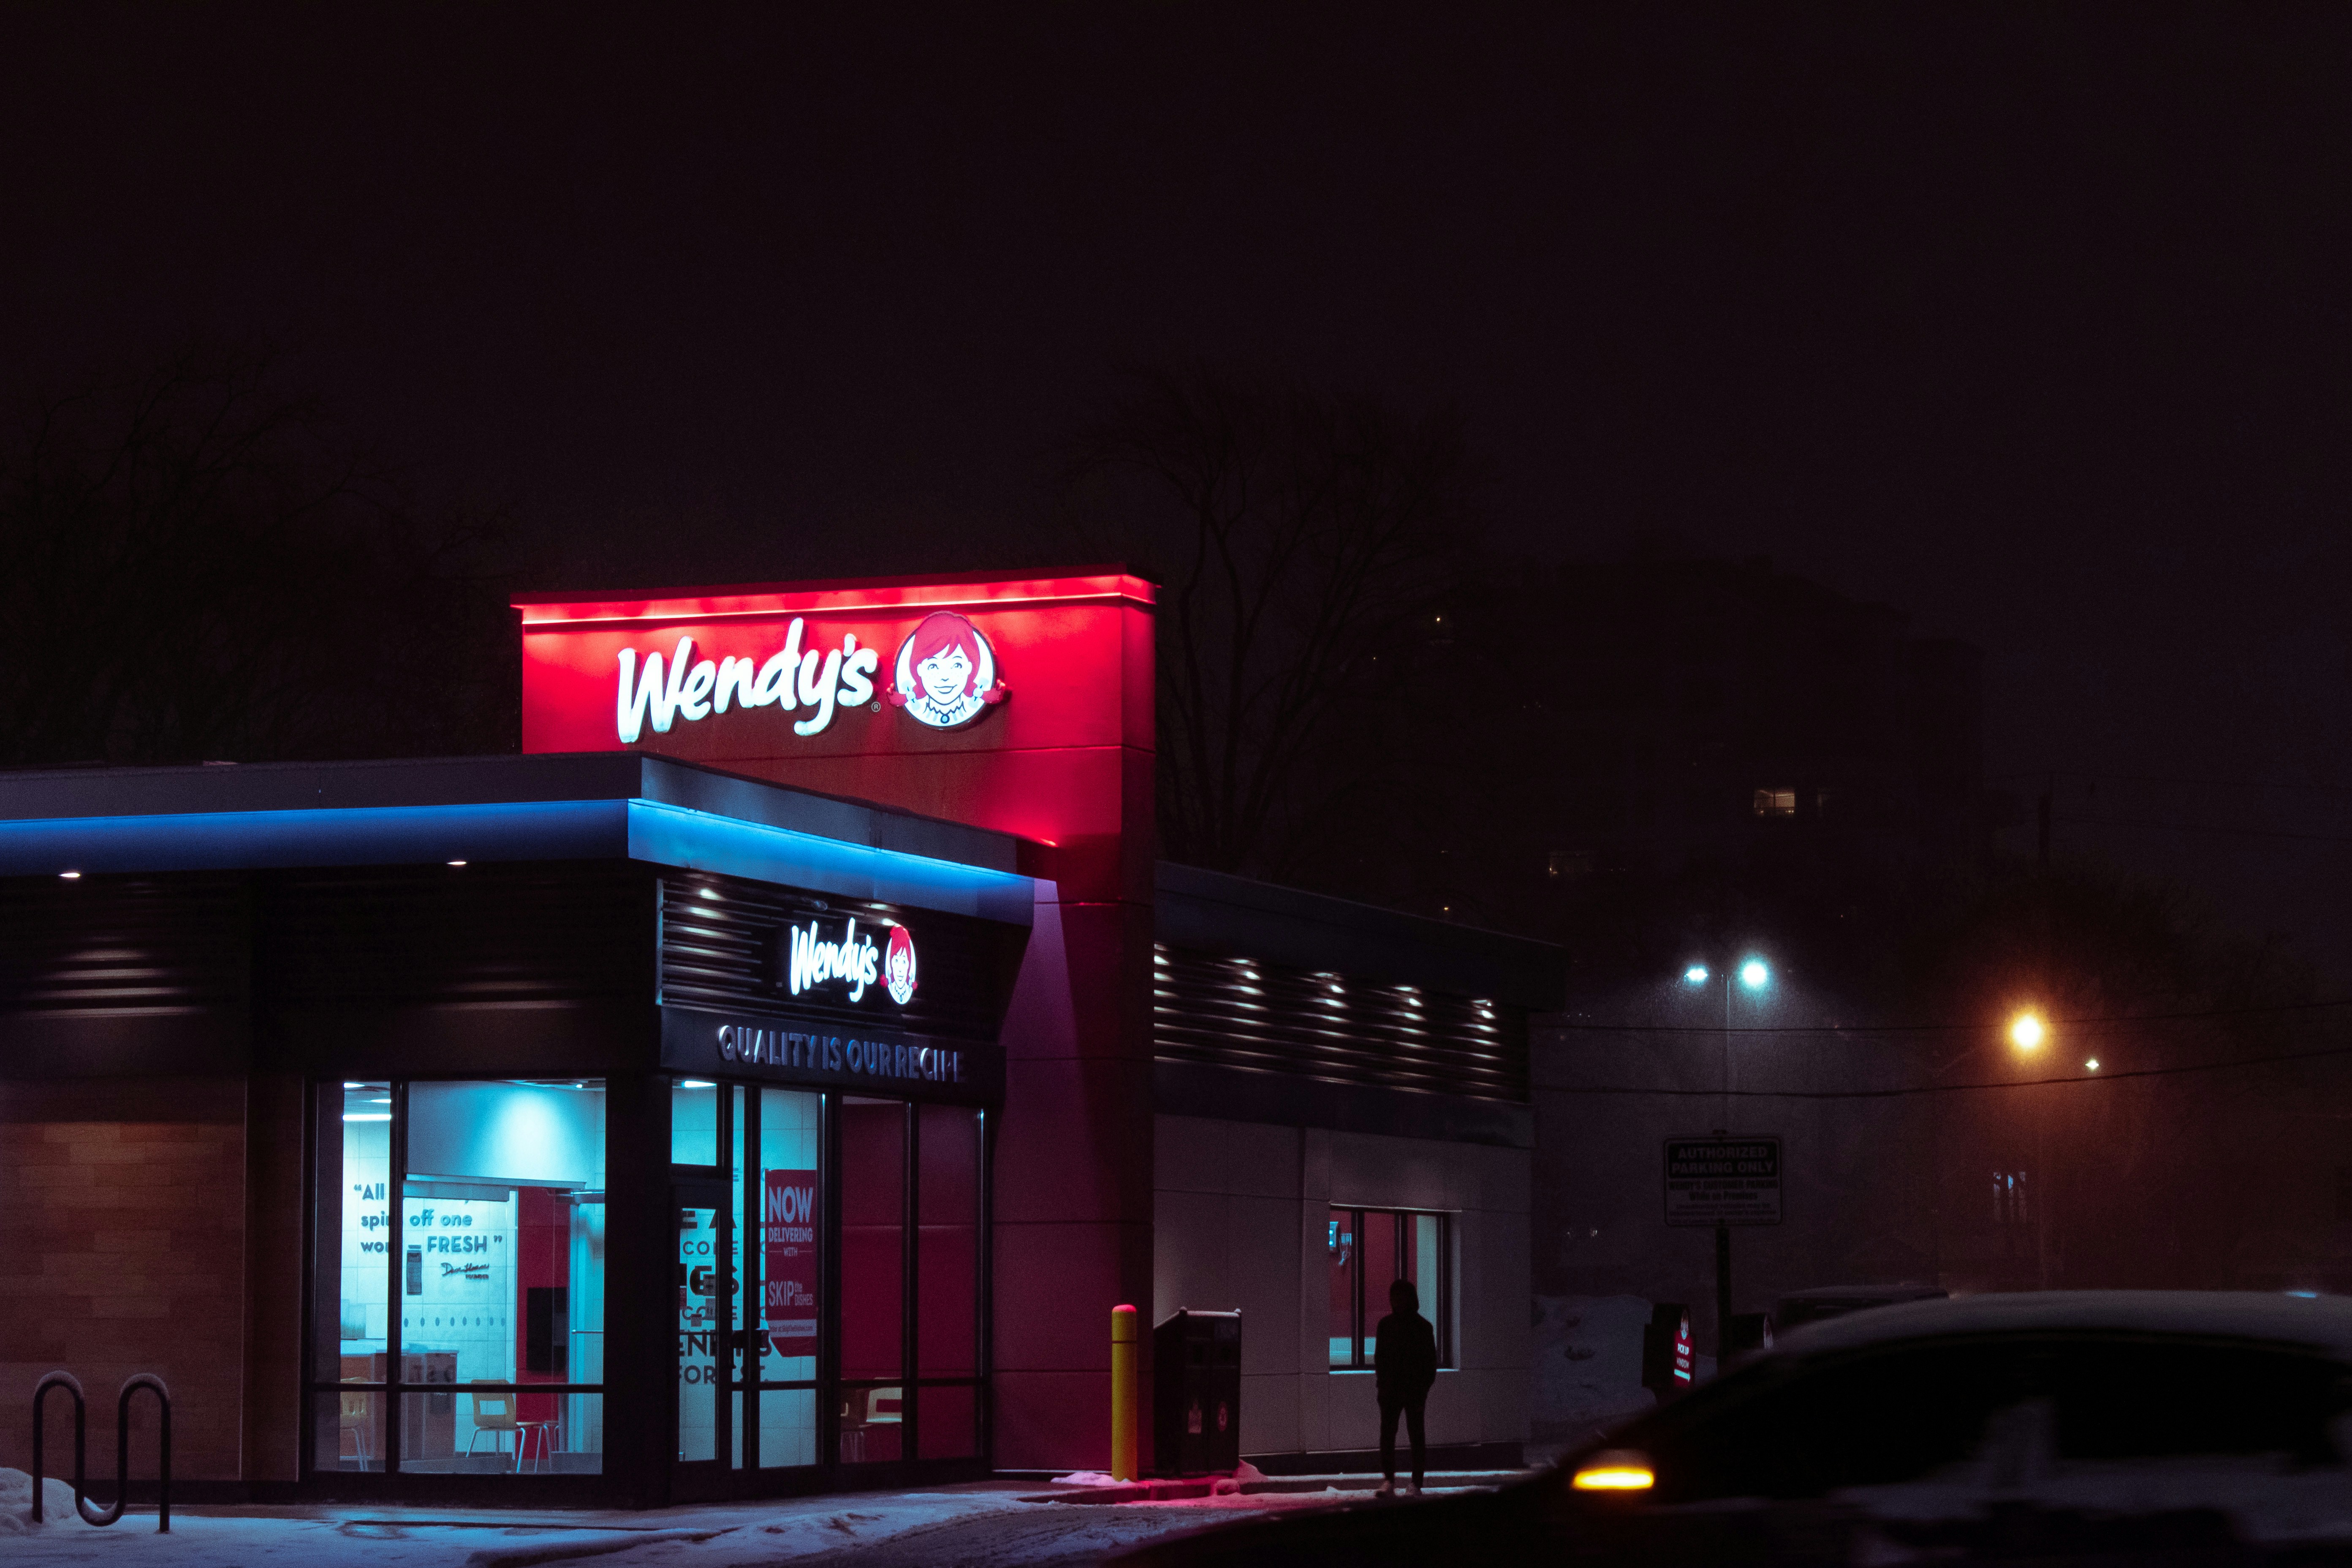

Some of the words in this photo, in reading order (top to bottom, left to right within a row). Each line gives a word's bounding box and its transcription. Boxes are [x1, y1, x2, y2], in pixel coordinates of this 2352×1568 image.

[617, 618, 878, 742] Wendy's
[790, 917, 878, 1002] Wendy's
[719, 1025, 817, 1068] QUALITY
[822, 1036, 842, 1071] IS
[847, 1039, 891, 1076] OUR
[895, 1045, 965, 1082] RECIPE
[1678, 1146, 1768, 1159] AUTHORIZED
[1671, 1162, 1733, 1174] PARKING
[1737, 1161, 1774, 1173] ONLY
[769, 1186, 813, 1223] NOW
[410, 1209, 434, 1226] off
[440, 1214, 473, 1226] one
[769, 1227, 813, 1243] DELIVERING
[783, 1247, 798, 1257] WITH
[769, 1280, 794, 1307] SKIP
[795, 1294, 813, 1306] DISHES
